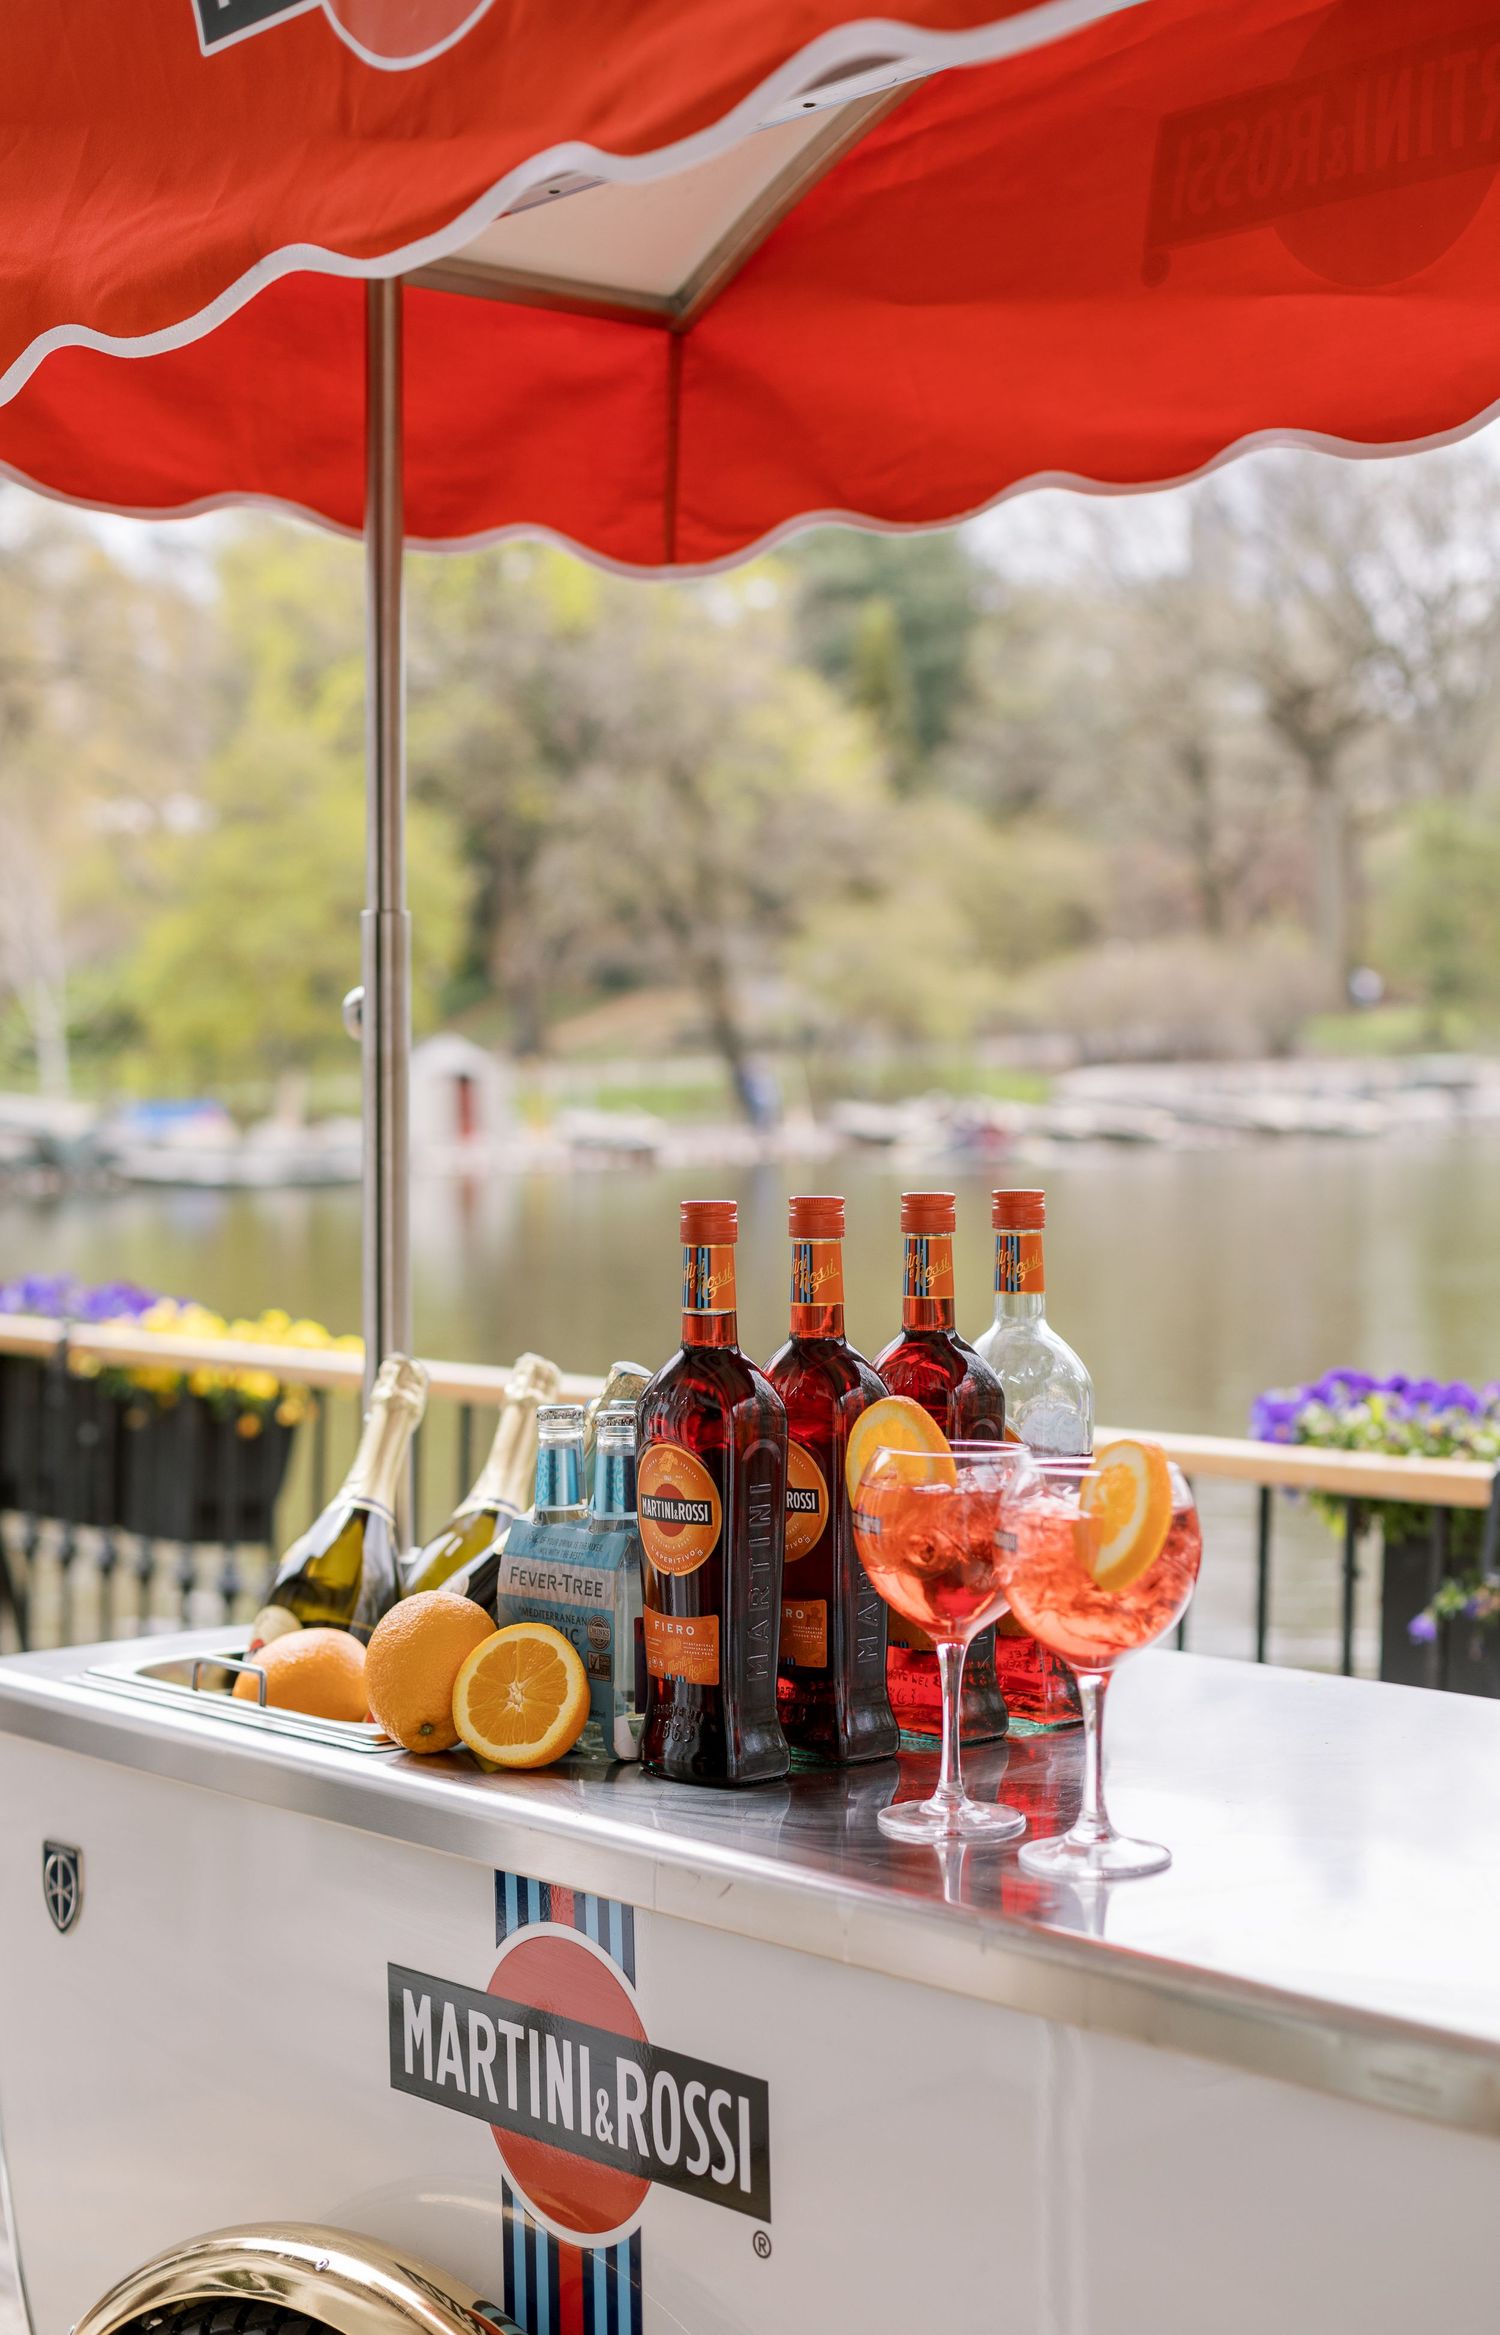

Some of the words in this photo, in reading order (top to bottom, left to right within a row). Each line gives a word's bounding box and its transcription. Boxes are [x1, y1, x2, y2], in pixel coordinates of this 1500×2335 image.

[641, 1496, 709, 1523] MARTINI&ROSSI
[509, 1566, 603, 1598] FEVER-TREE
[654, 1620, 695, 1636] FIERO
[402, 1987, 752, 2195] MARTINI&ROSSI
